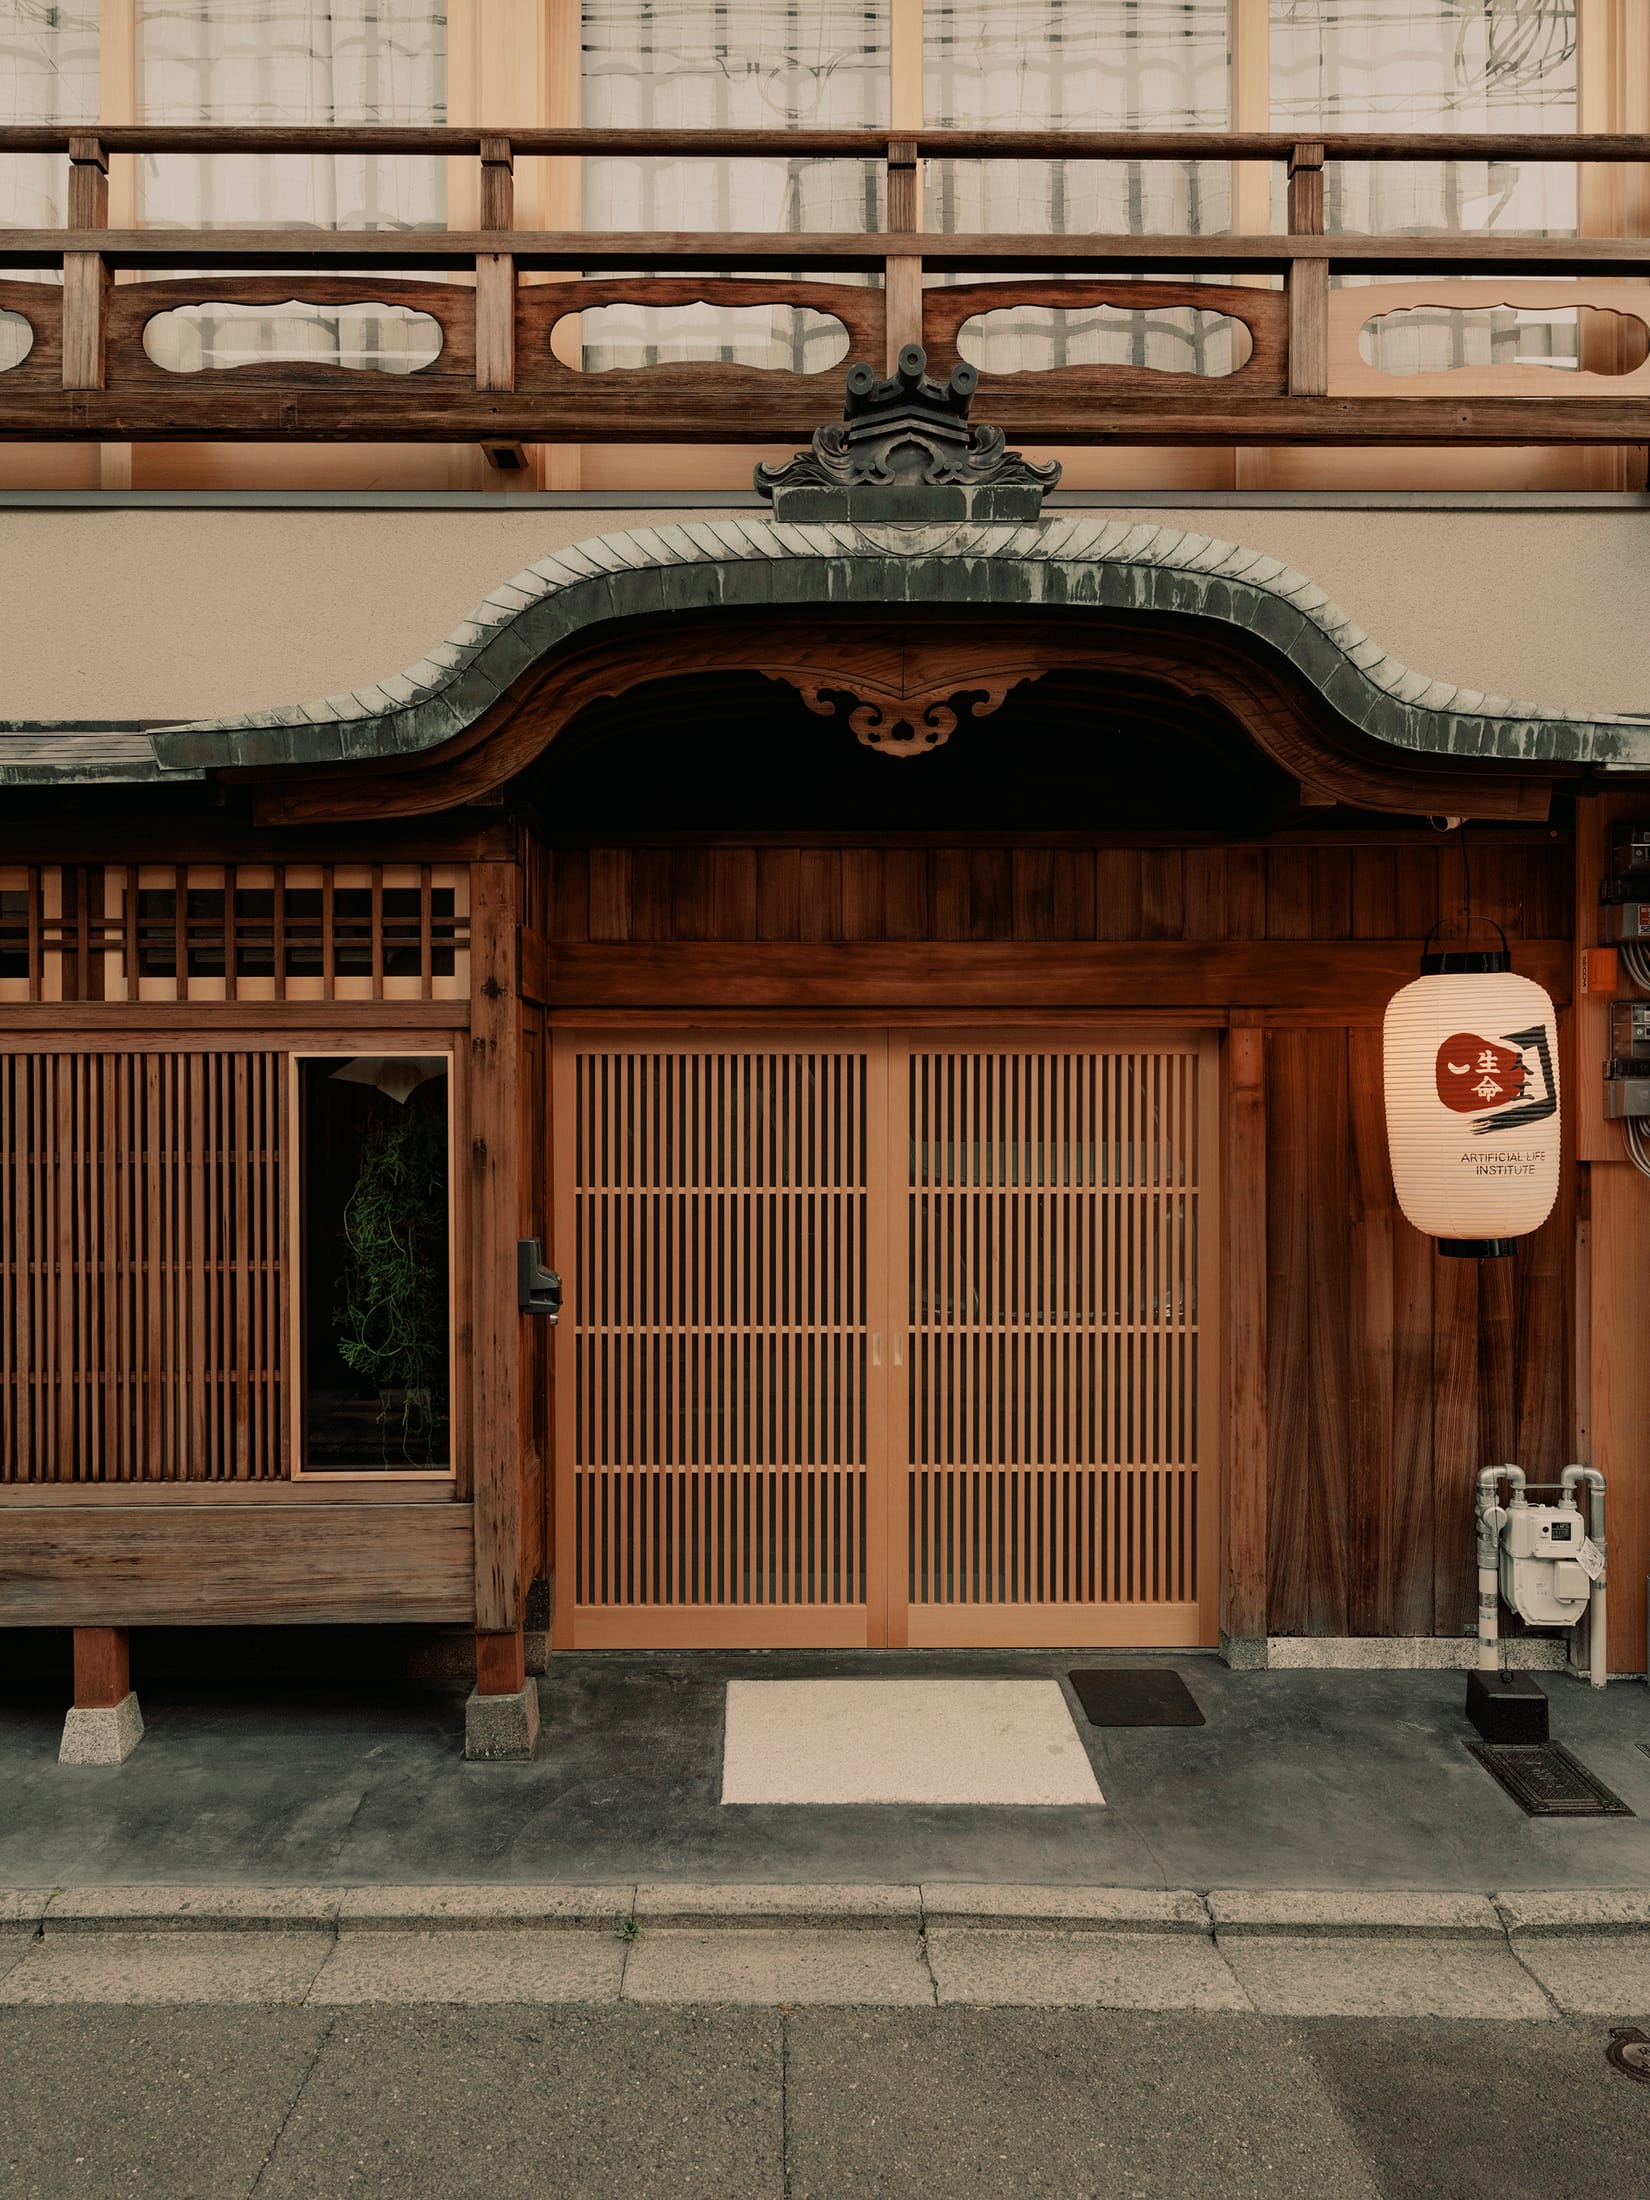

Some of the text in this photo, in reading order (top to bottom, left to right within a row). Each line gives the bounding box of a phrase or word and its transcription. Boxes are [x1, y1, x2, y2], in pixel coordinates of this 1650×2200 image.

[1461, 1151, 1546, 1162] ARTIFICIAL LIFE
[1476, 1164, 1536, 1176] INSTITUTE
